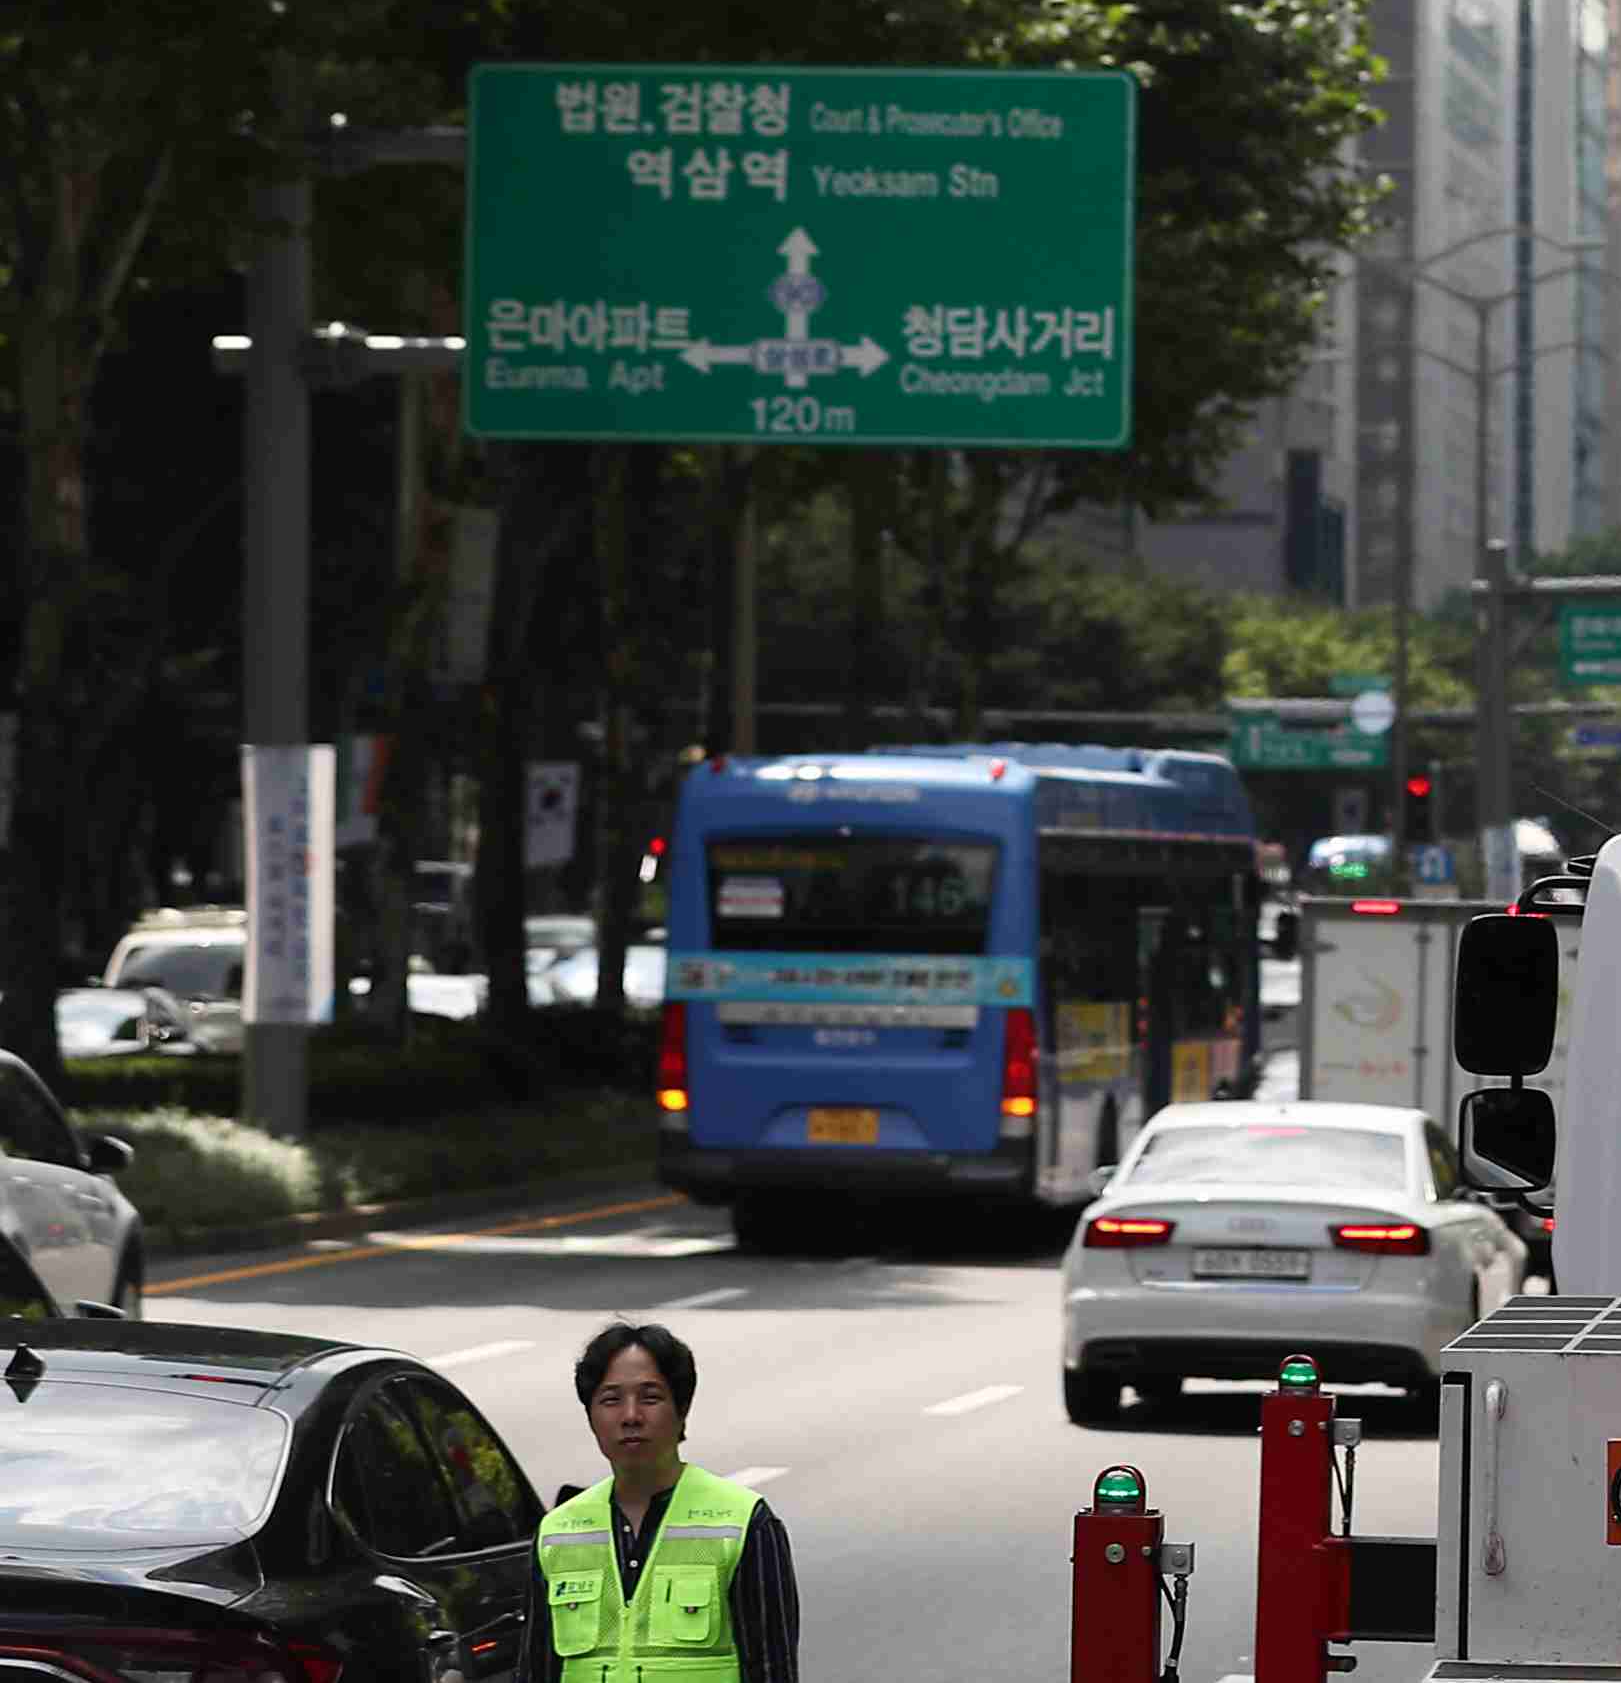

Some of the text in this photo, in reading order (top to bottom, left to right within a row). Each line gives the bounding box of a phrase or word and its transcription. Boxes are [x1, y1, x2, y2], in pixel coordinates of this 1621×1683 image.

[1007, 107, 1063, 138] Office
[627, 146, 789, 202] 역삼역
[812, 163, 998, 197] Yeoksam Stn
[485, 299, 690, 351] 은마아파트
[902, 305, 1114, 358] 청담사거리
[486, 358, 664, 393] Eunma Apt
[899, 364, 1105, 403] Cheongdam Jct
